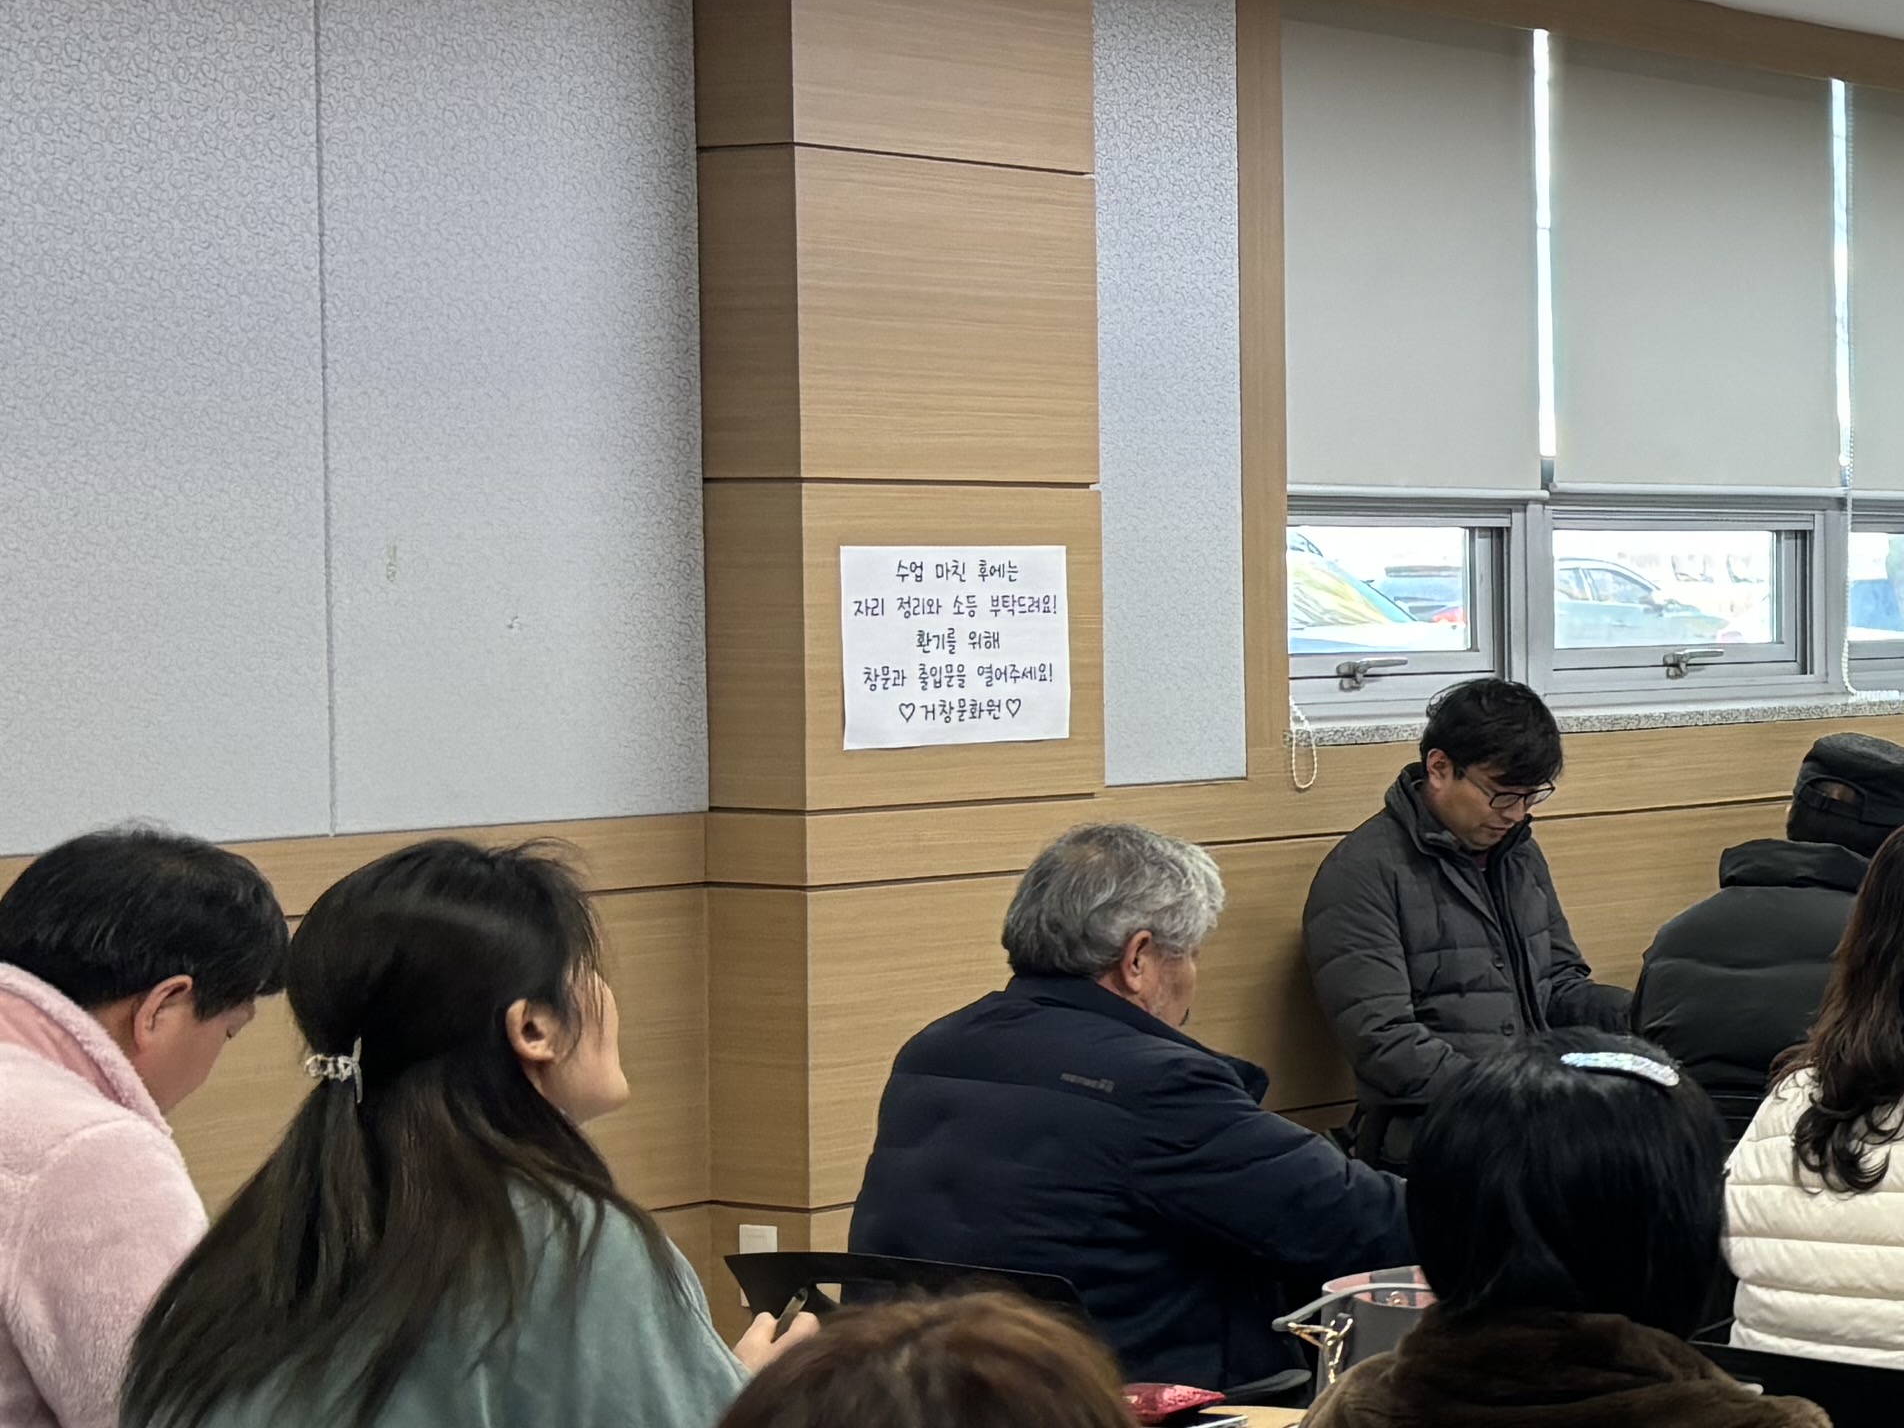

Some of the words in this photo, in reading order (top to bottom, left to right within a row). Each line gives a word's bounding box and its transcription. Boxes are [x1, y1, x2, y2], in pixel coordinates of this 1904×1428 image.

[895, 560, 924, 583] 수업
[935, 559, 966, 583] 마친
[978, 559, 1020, 583] 후에는
[853, 597, 885, 617] 자리
[896, 596, 943, 619] 정리와
[952, 595, 978, 618] 소등
[989, 593, 1058, 616] 부탁드려요!
[915, 627, 957, 655] 환기를
[967, 630, 1001, 651] 위해
[862, 666, 908, 692] 창문과
[917, 662, 967, 691] 출입문을
[976, 662, 1053, 688] 열어주세요!
[920, 698, 1001, 724] 거창문화원
